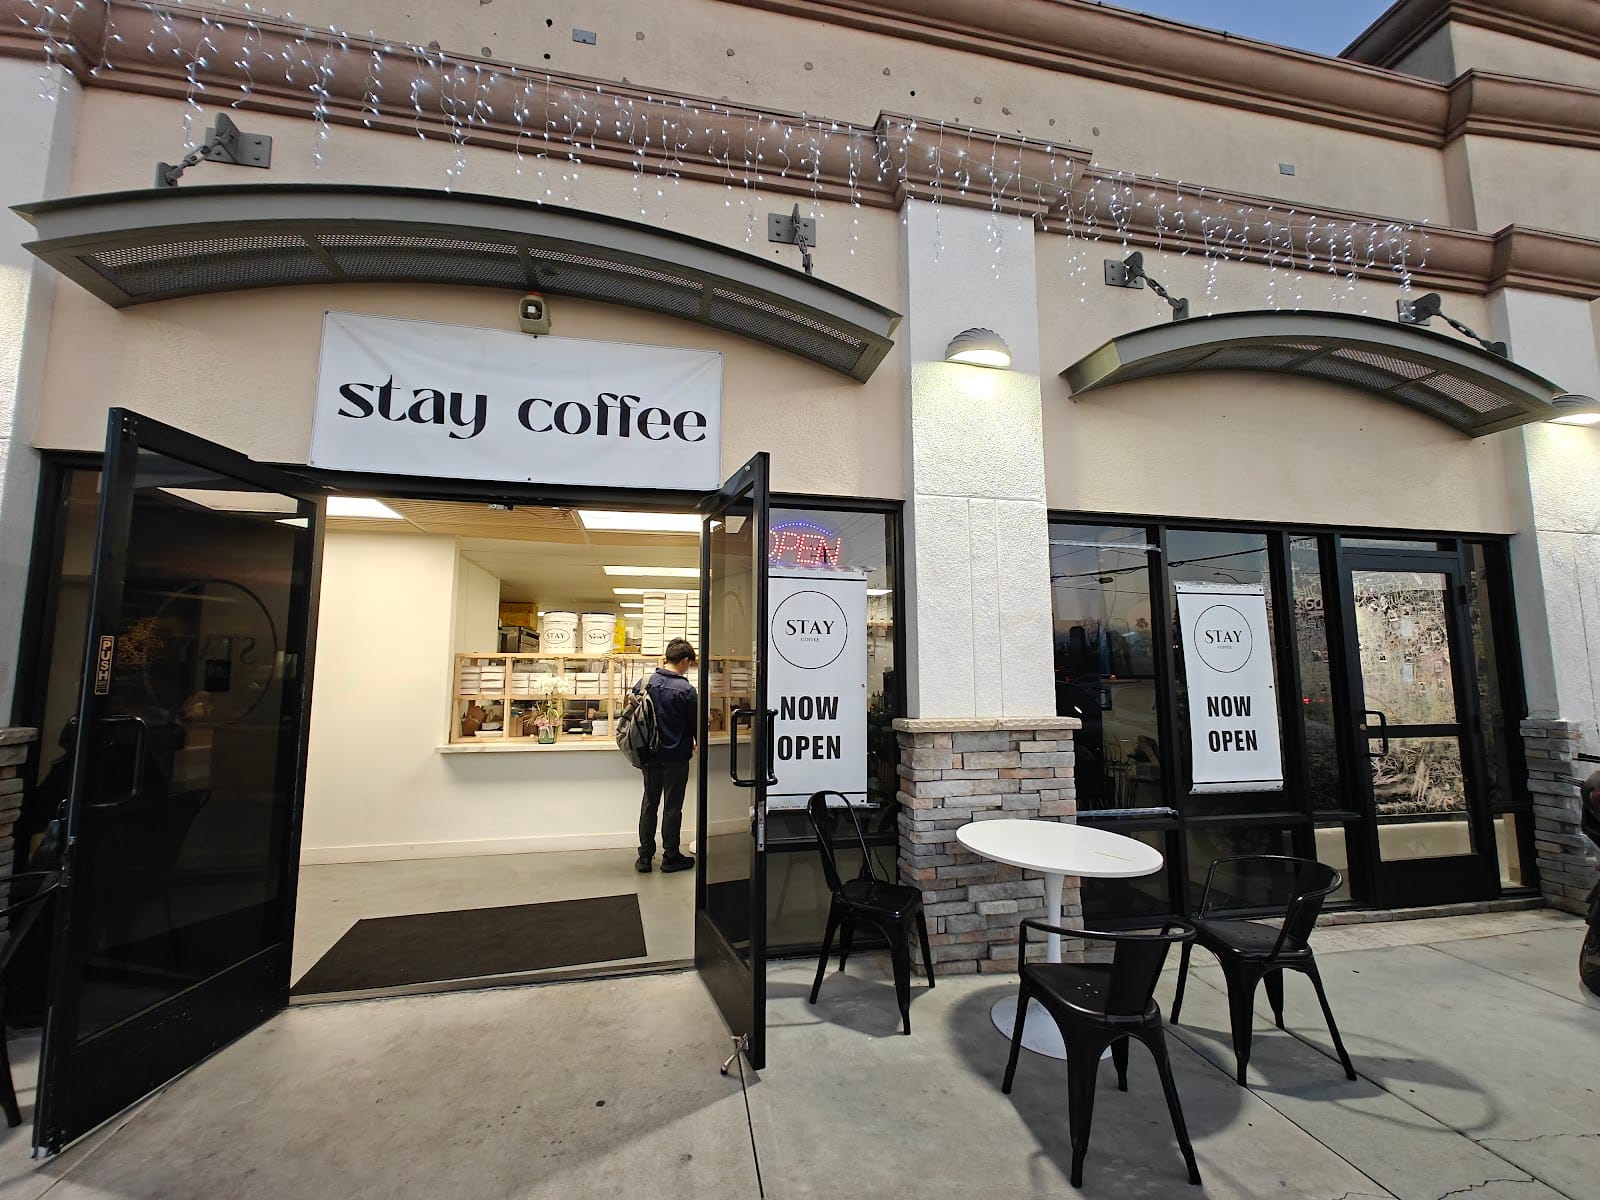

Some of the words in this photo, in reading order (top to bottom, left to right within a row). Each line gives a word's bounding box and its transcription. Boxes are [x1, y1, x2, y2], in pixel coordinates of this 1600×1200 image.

[337, 374, 488, 440] stay
[517, 392, 707, 442] coffee
[546, 632, 566, 640] STAY
[785, 619, 835, 636] STAY
[1205, 629, 1242, 644] STAY
[98, 640, 112, 681] PUSH
[780, 693, 839, 721] NOW
[1206, 695, 1251, 718] NOW
[777, 735, 841, 761] OPEN
[1208, 729, 1258, 752] OPEN
